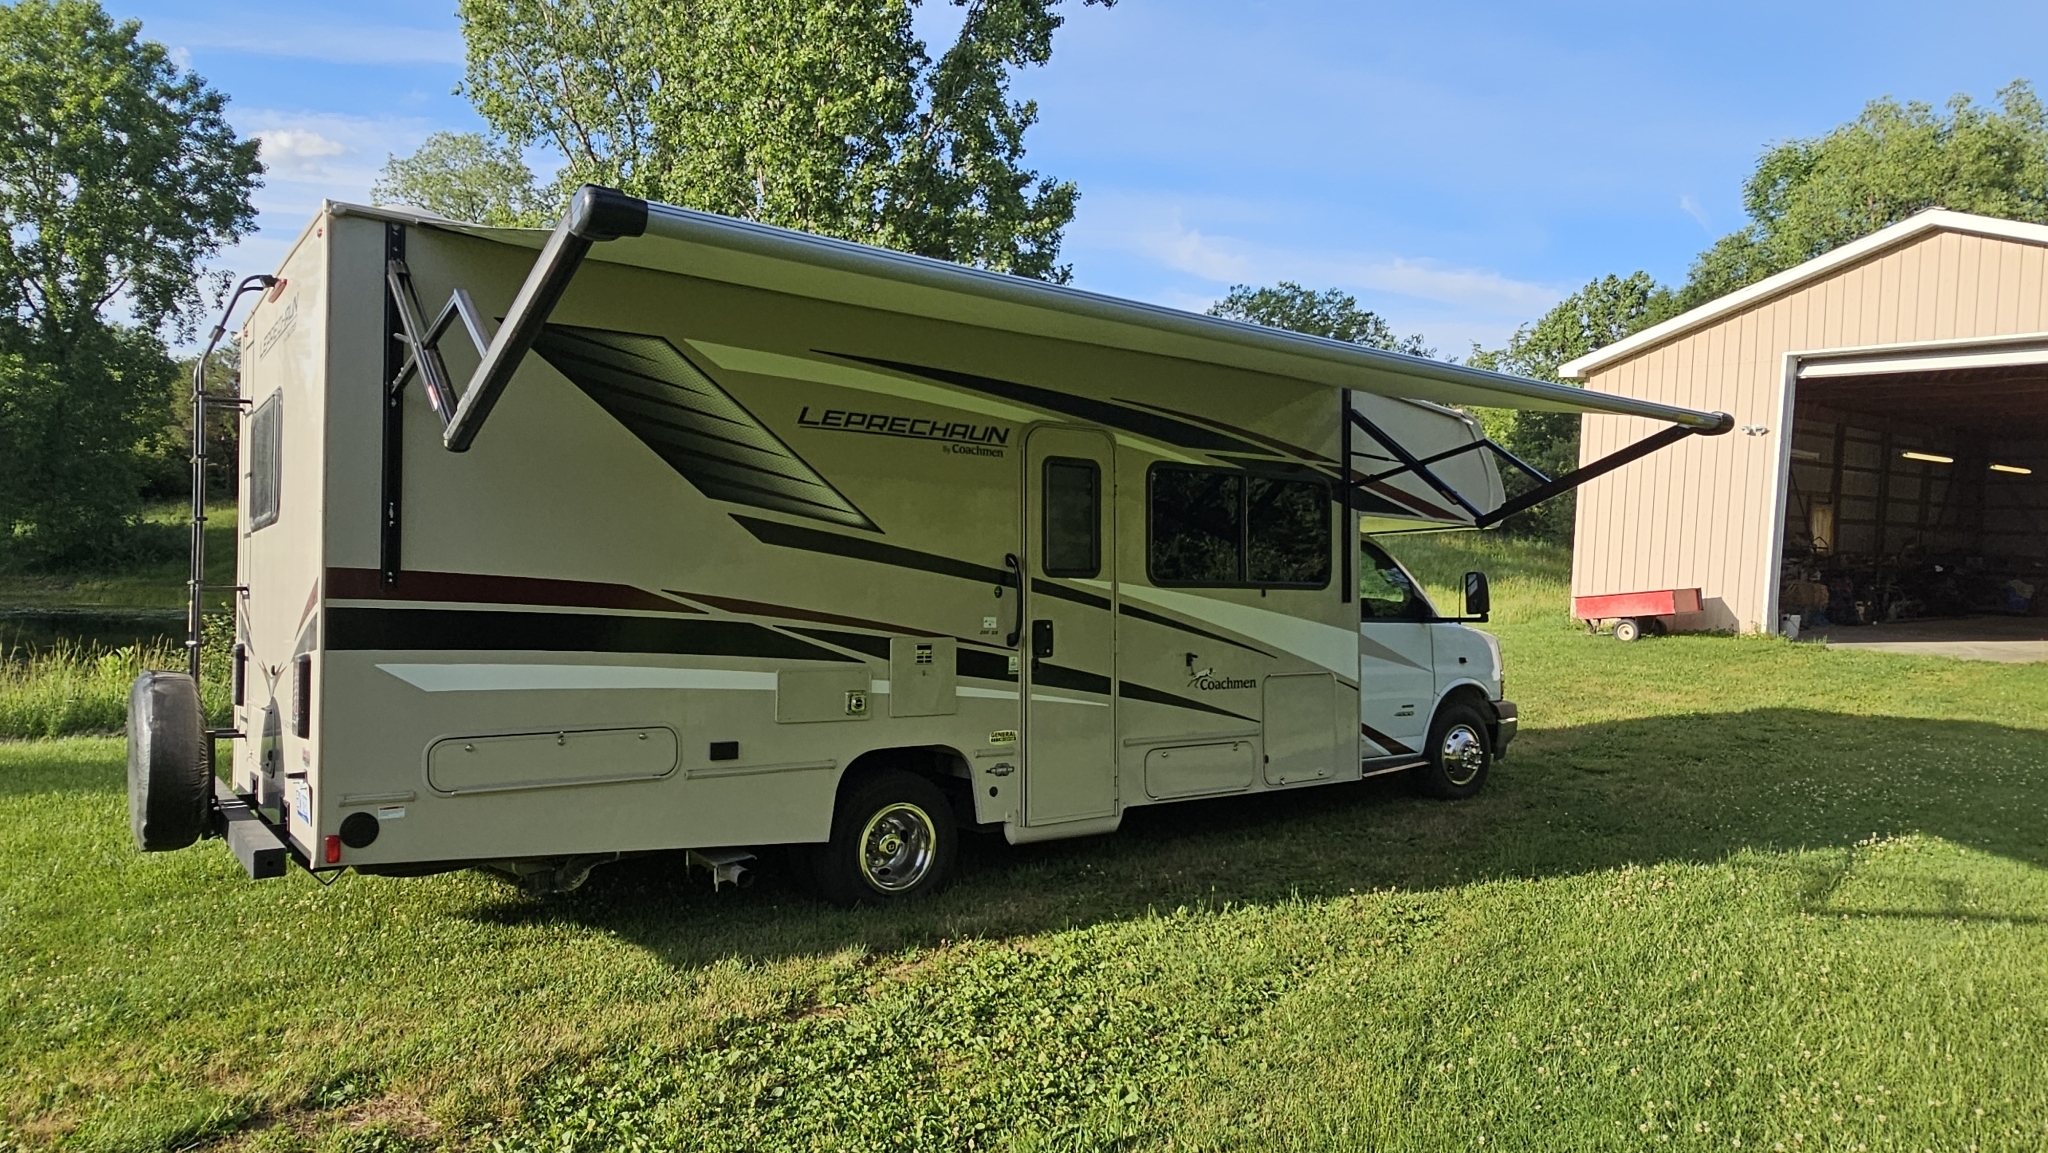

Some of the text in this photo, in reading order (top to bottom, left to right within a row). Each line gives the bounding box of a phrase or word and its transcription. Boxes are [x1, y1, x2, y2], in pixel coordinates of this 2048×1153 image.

[798, 407, 1010, 444] LEPRECHAUN
[952, 444, 1003, 458] Coachmen
[1200, 677, 1256, 690] Coachmen
